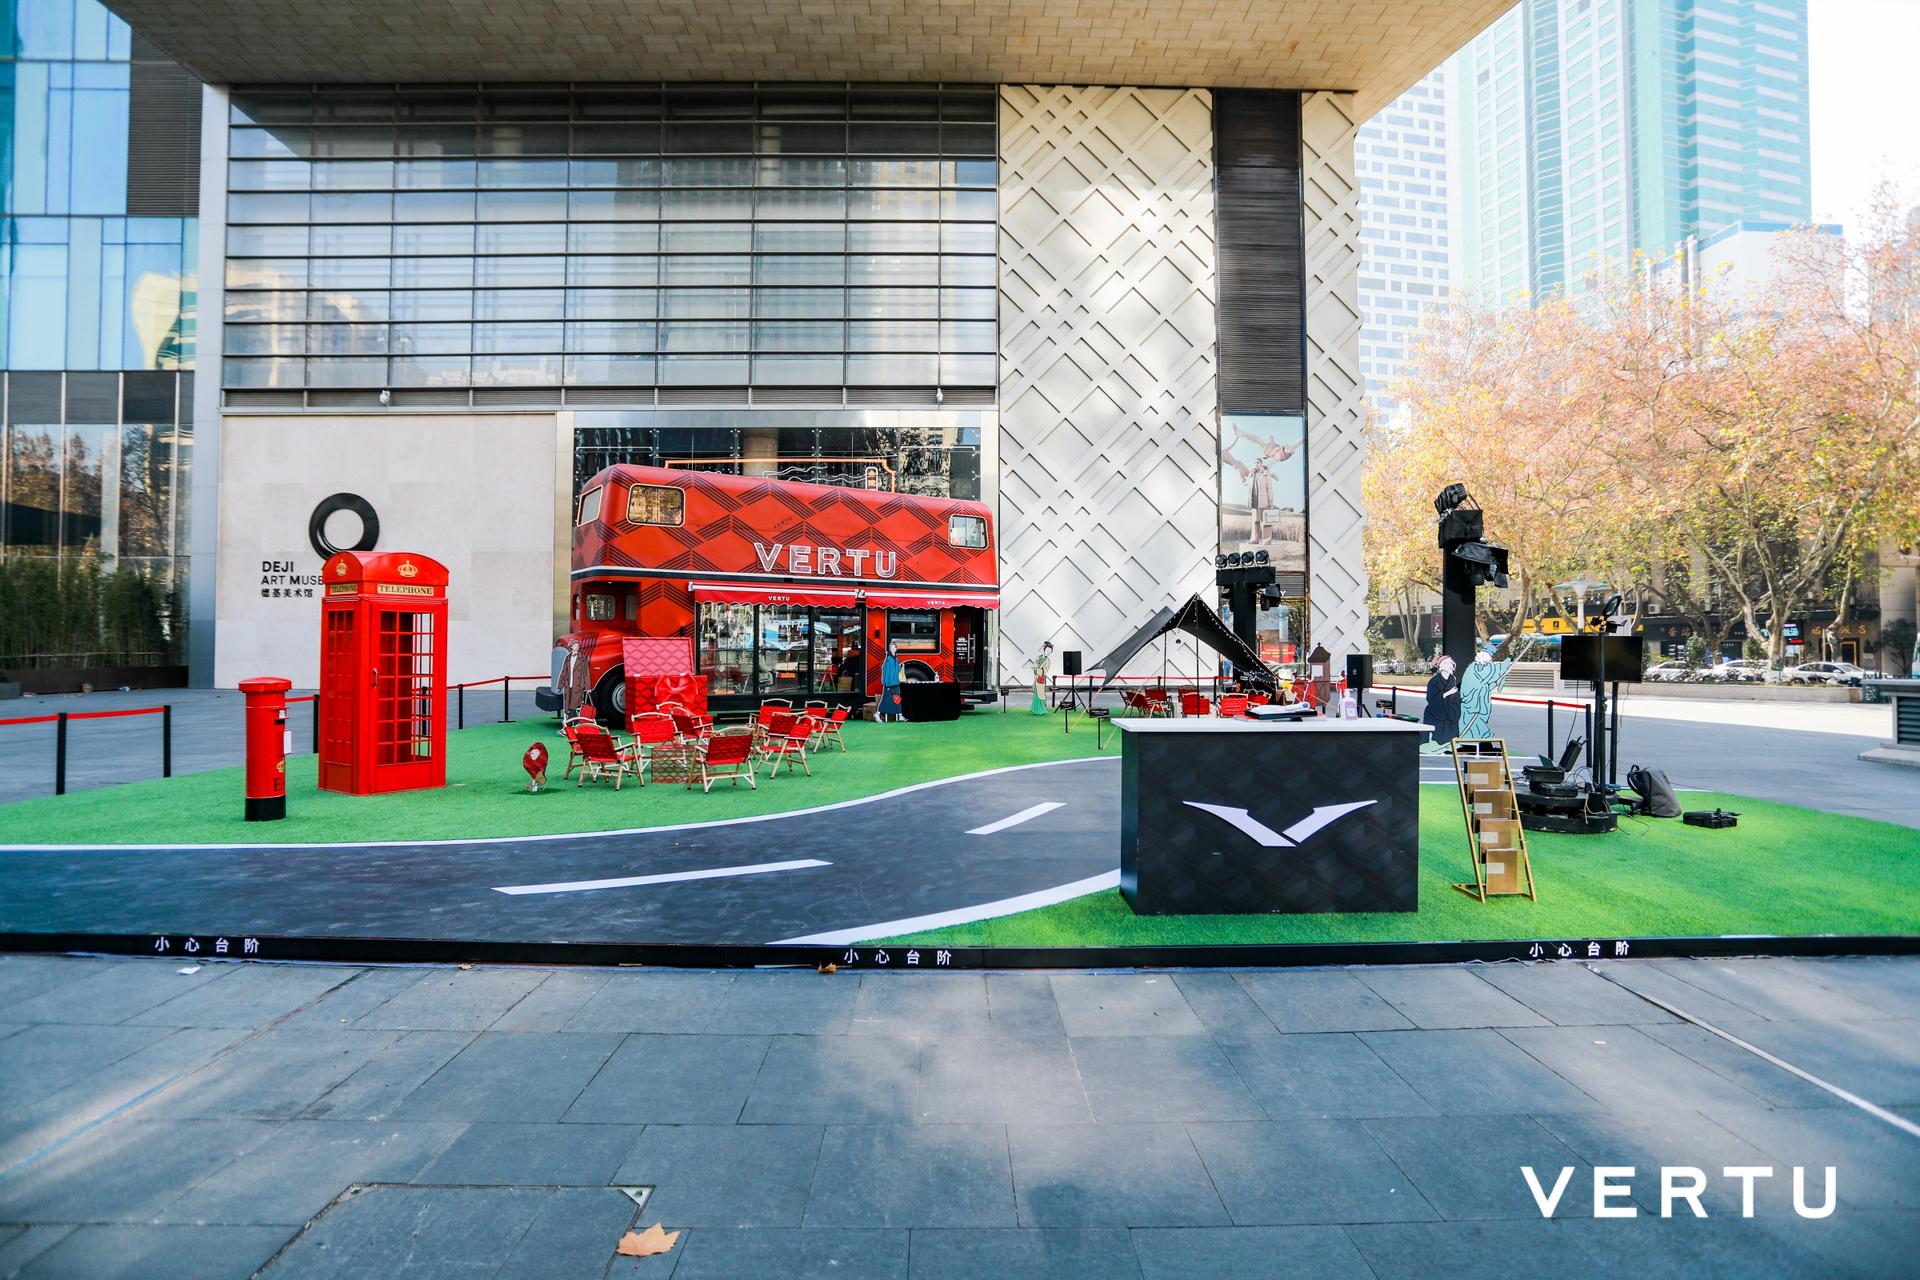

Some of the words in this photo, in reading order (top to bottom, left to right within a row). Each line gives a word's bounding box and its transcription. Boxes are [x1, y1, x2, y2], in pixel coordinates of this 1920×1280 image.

[262, 561, 294, 572] DEJI
[754, 542, 896, 578] VERTU
[261, 575, 286, 585] ART
[261, 588, 313, 598] 德基美术馆
[378, 584, 433, 595] TELEPHONE
[155, 936, 260, 954] 小心台阶
[1529, 940, 1630, 957] 小心台阶
[844, 949, 952, 966] 小心台阶
